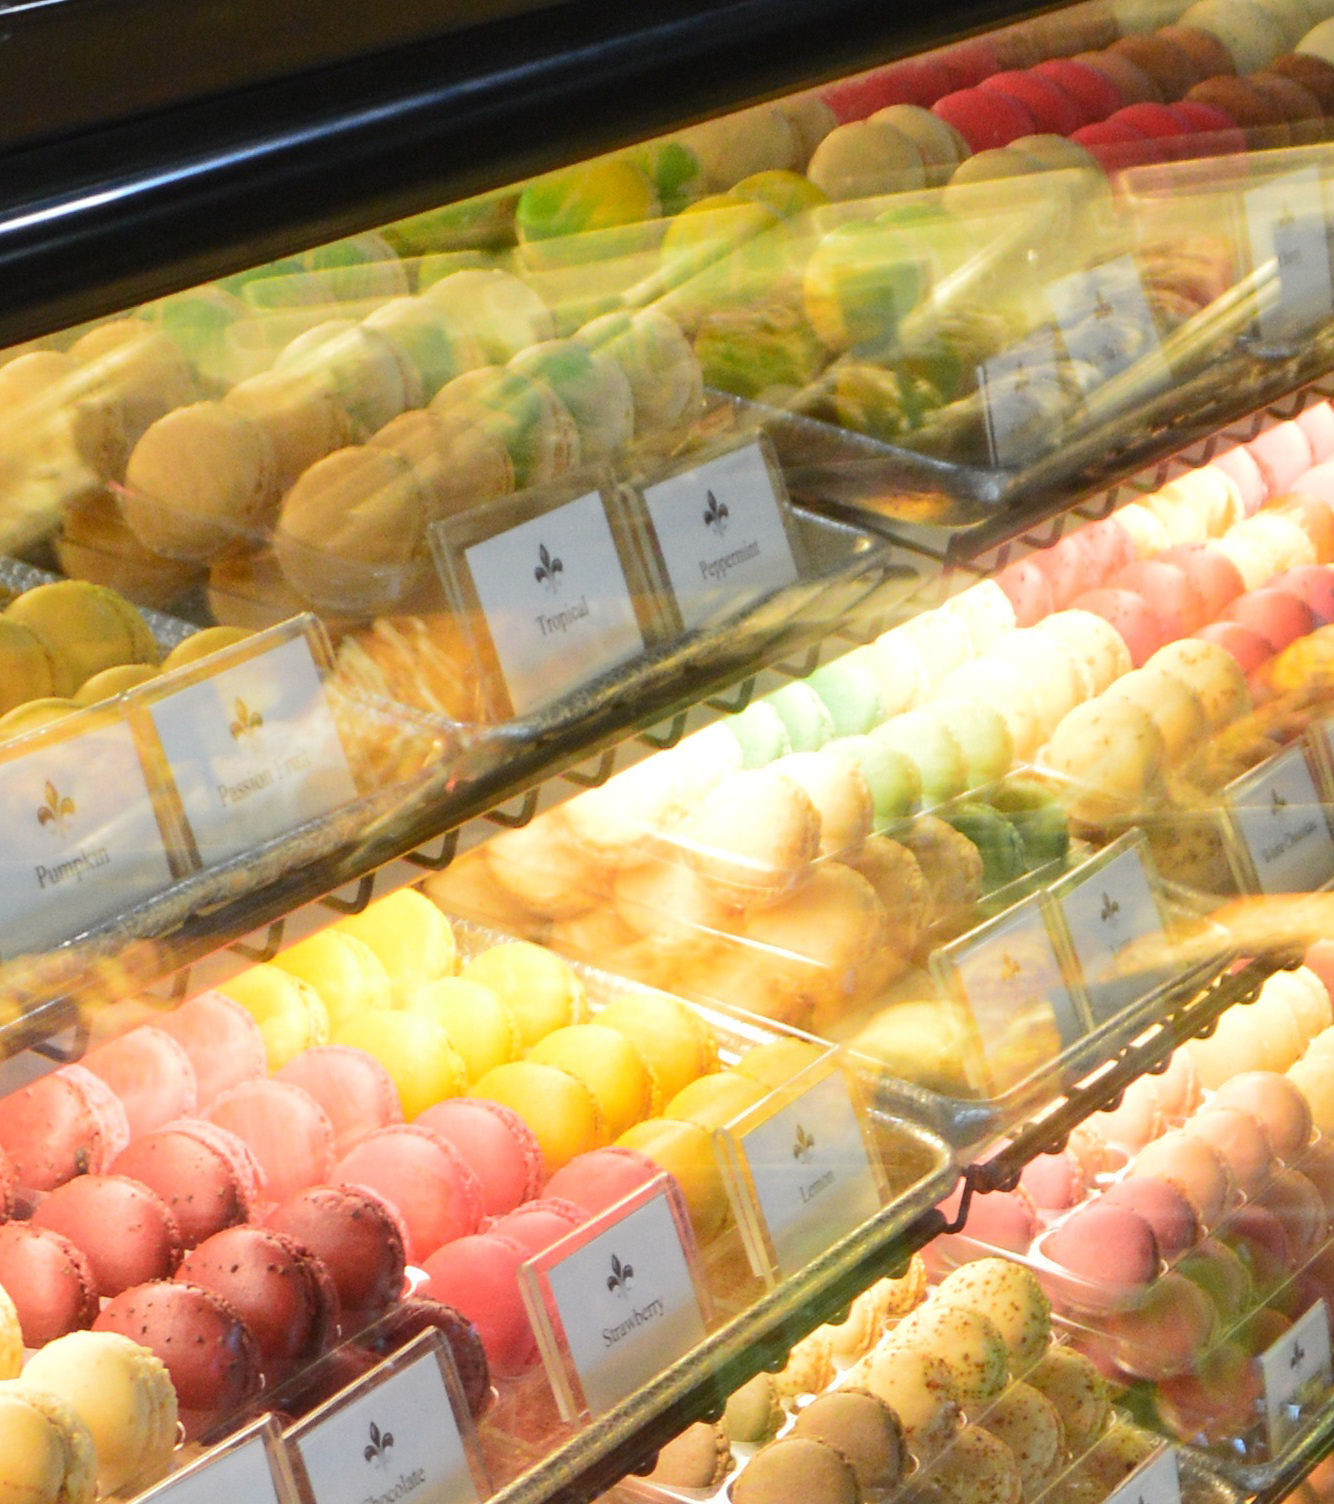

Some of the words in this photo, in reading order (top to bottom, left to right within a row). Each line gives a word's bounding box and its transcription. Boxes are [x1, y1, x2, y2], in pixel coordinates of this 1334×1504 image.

[534, 595, 590, 636] Tropical
[217, 767, 274, 808] Passion
[34, 845, 111, 890] Pumpkin
[798, 1169, 836, 1205] Lemon
[601, 1297, 665, 1349] Strawberry
